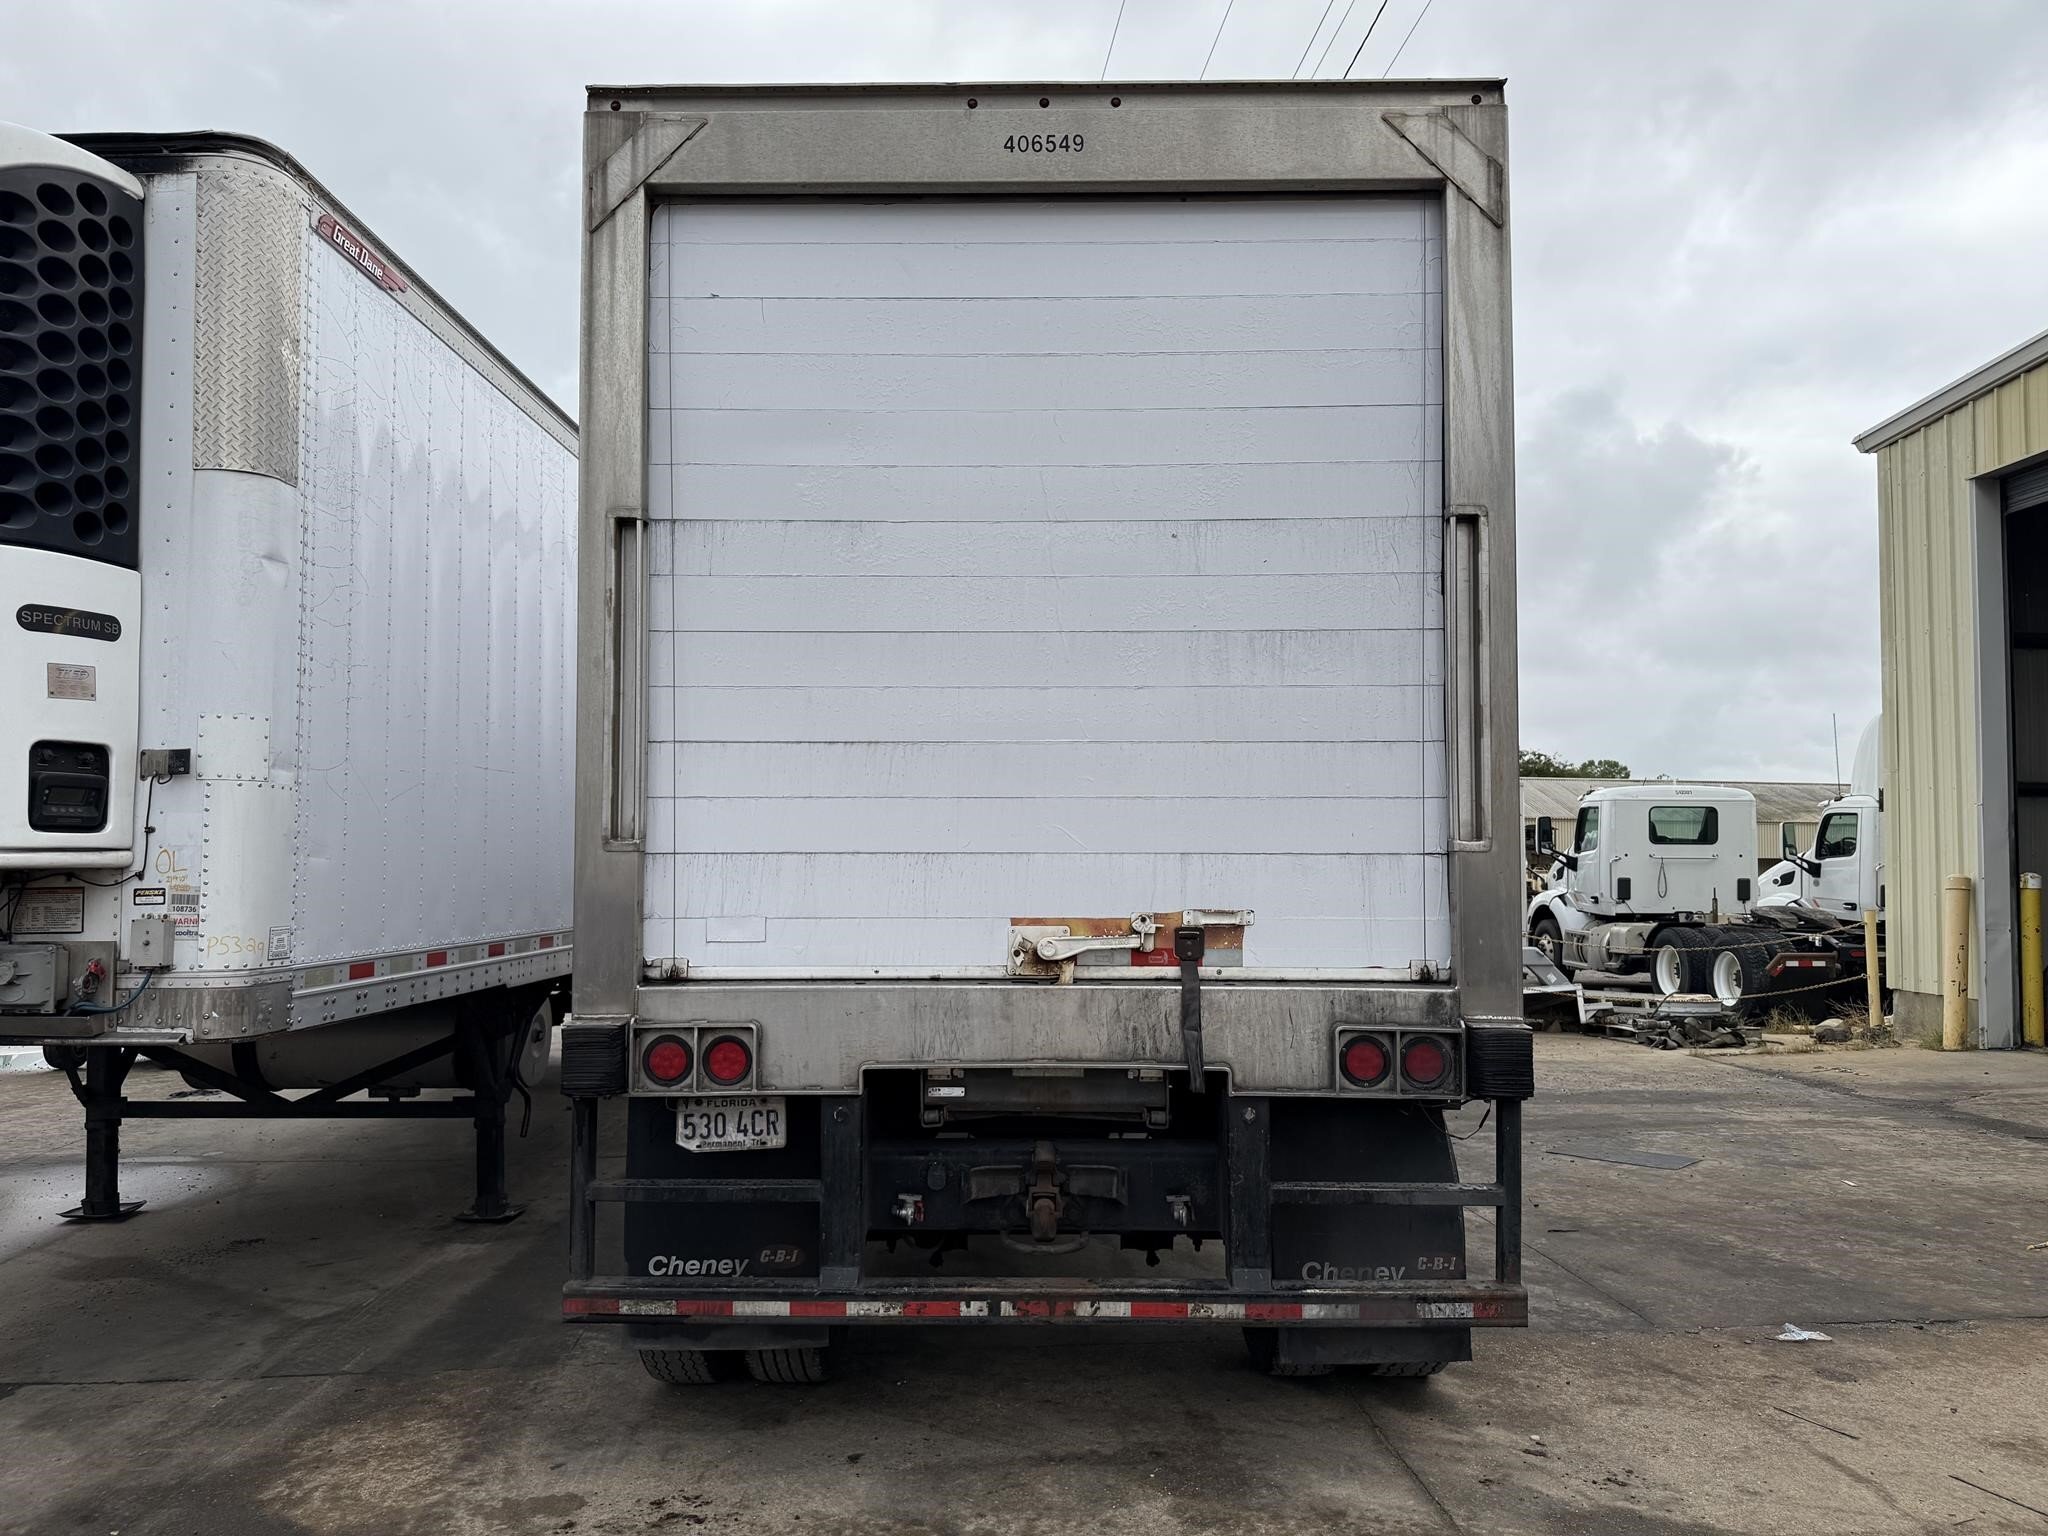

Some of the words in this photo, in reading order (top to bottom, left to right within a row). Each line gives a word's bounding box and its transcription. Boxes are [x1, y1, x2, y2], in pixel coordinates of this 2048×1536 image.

[1003, 134, 1085, 153] 406549
[333, 225, 360, 259] Great
[360, 248, 383, 279] Dane
[21, 610, 101, 632] SPECTRUM
[104, 622, 119, 635] SB
[135, 889, 165, 897] PENSKE
[172, 905, 197, 913] 108736
[706, 1098, 756, 1108] FLORIDA
[683, 1111, 727, 1141] 530
[736, 1108, 780, 1138] 4CR
[702, 1139, 746, 1149] Permanent
[648, 1256, 750, 1278] Cheney
[1301, 1261, 1406, 1281] Cheney
